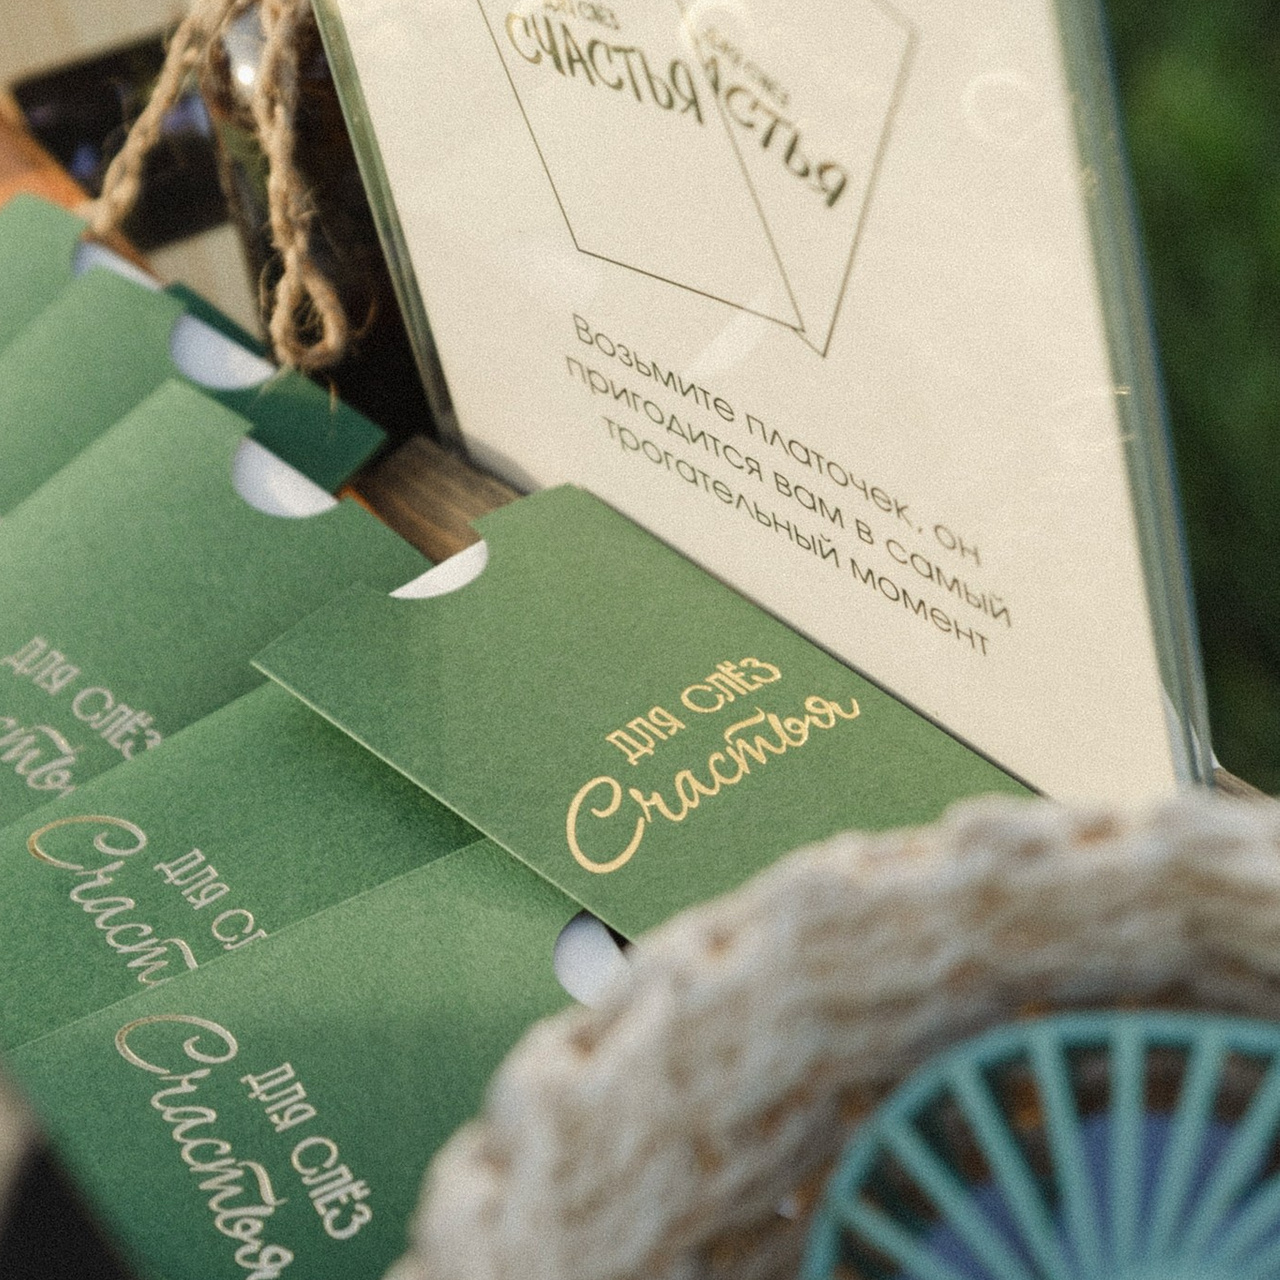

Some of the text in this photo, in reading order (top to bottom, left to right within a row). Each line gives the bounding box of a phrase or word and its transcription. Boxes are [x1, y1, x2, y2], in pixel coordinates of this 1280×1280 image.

[505, 12, 704, 125] СЧАСТЬЯ
[565, 355, 1012, 628] пригодится вам в самый
[572, 312, 982, 567] Возьмите платочек, он
[601, 415, 989, 657] трогательный момент
[0, 635, 82, 696] ДЛЯ
[605, 657, 782, 766] ДЛЯ СЛЁЗ
[566, 695, 861, 874] Счастья
[26, 814, 199, 987] Счаст
[153, 848, 231, 910] ДЛЯ
[240, 1062, 372, 1240] ДЛЯ СЛЁЗ
